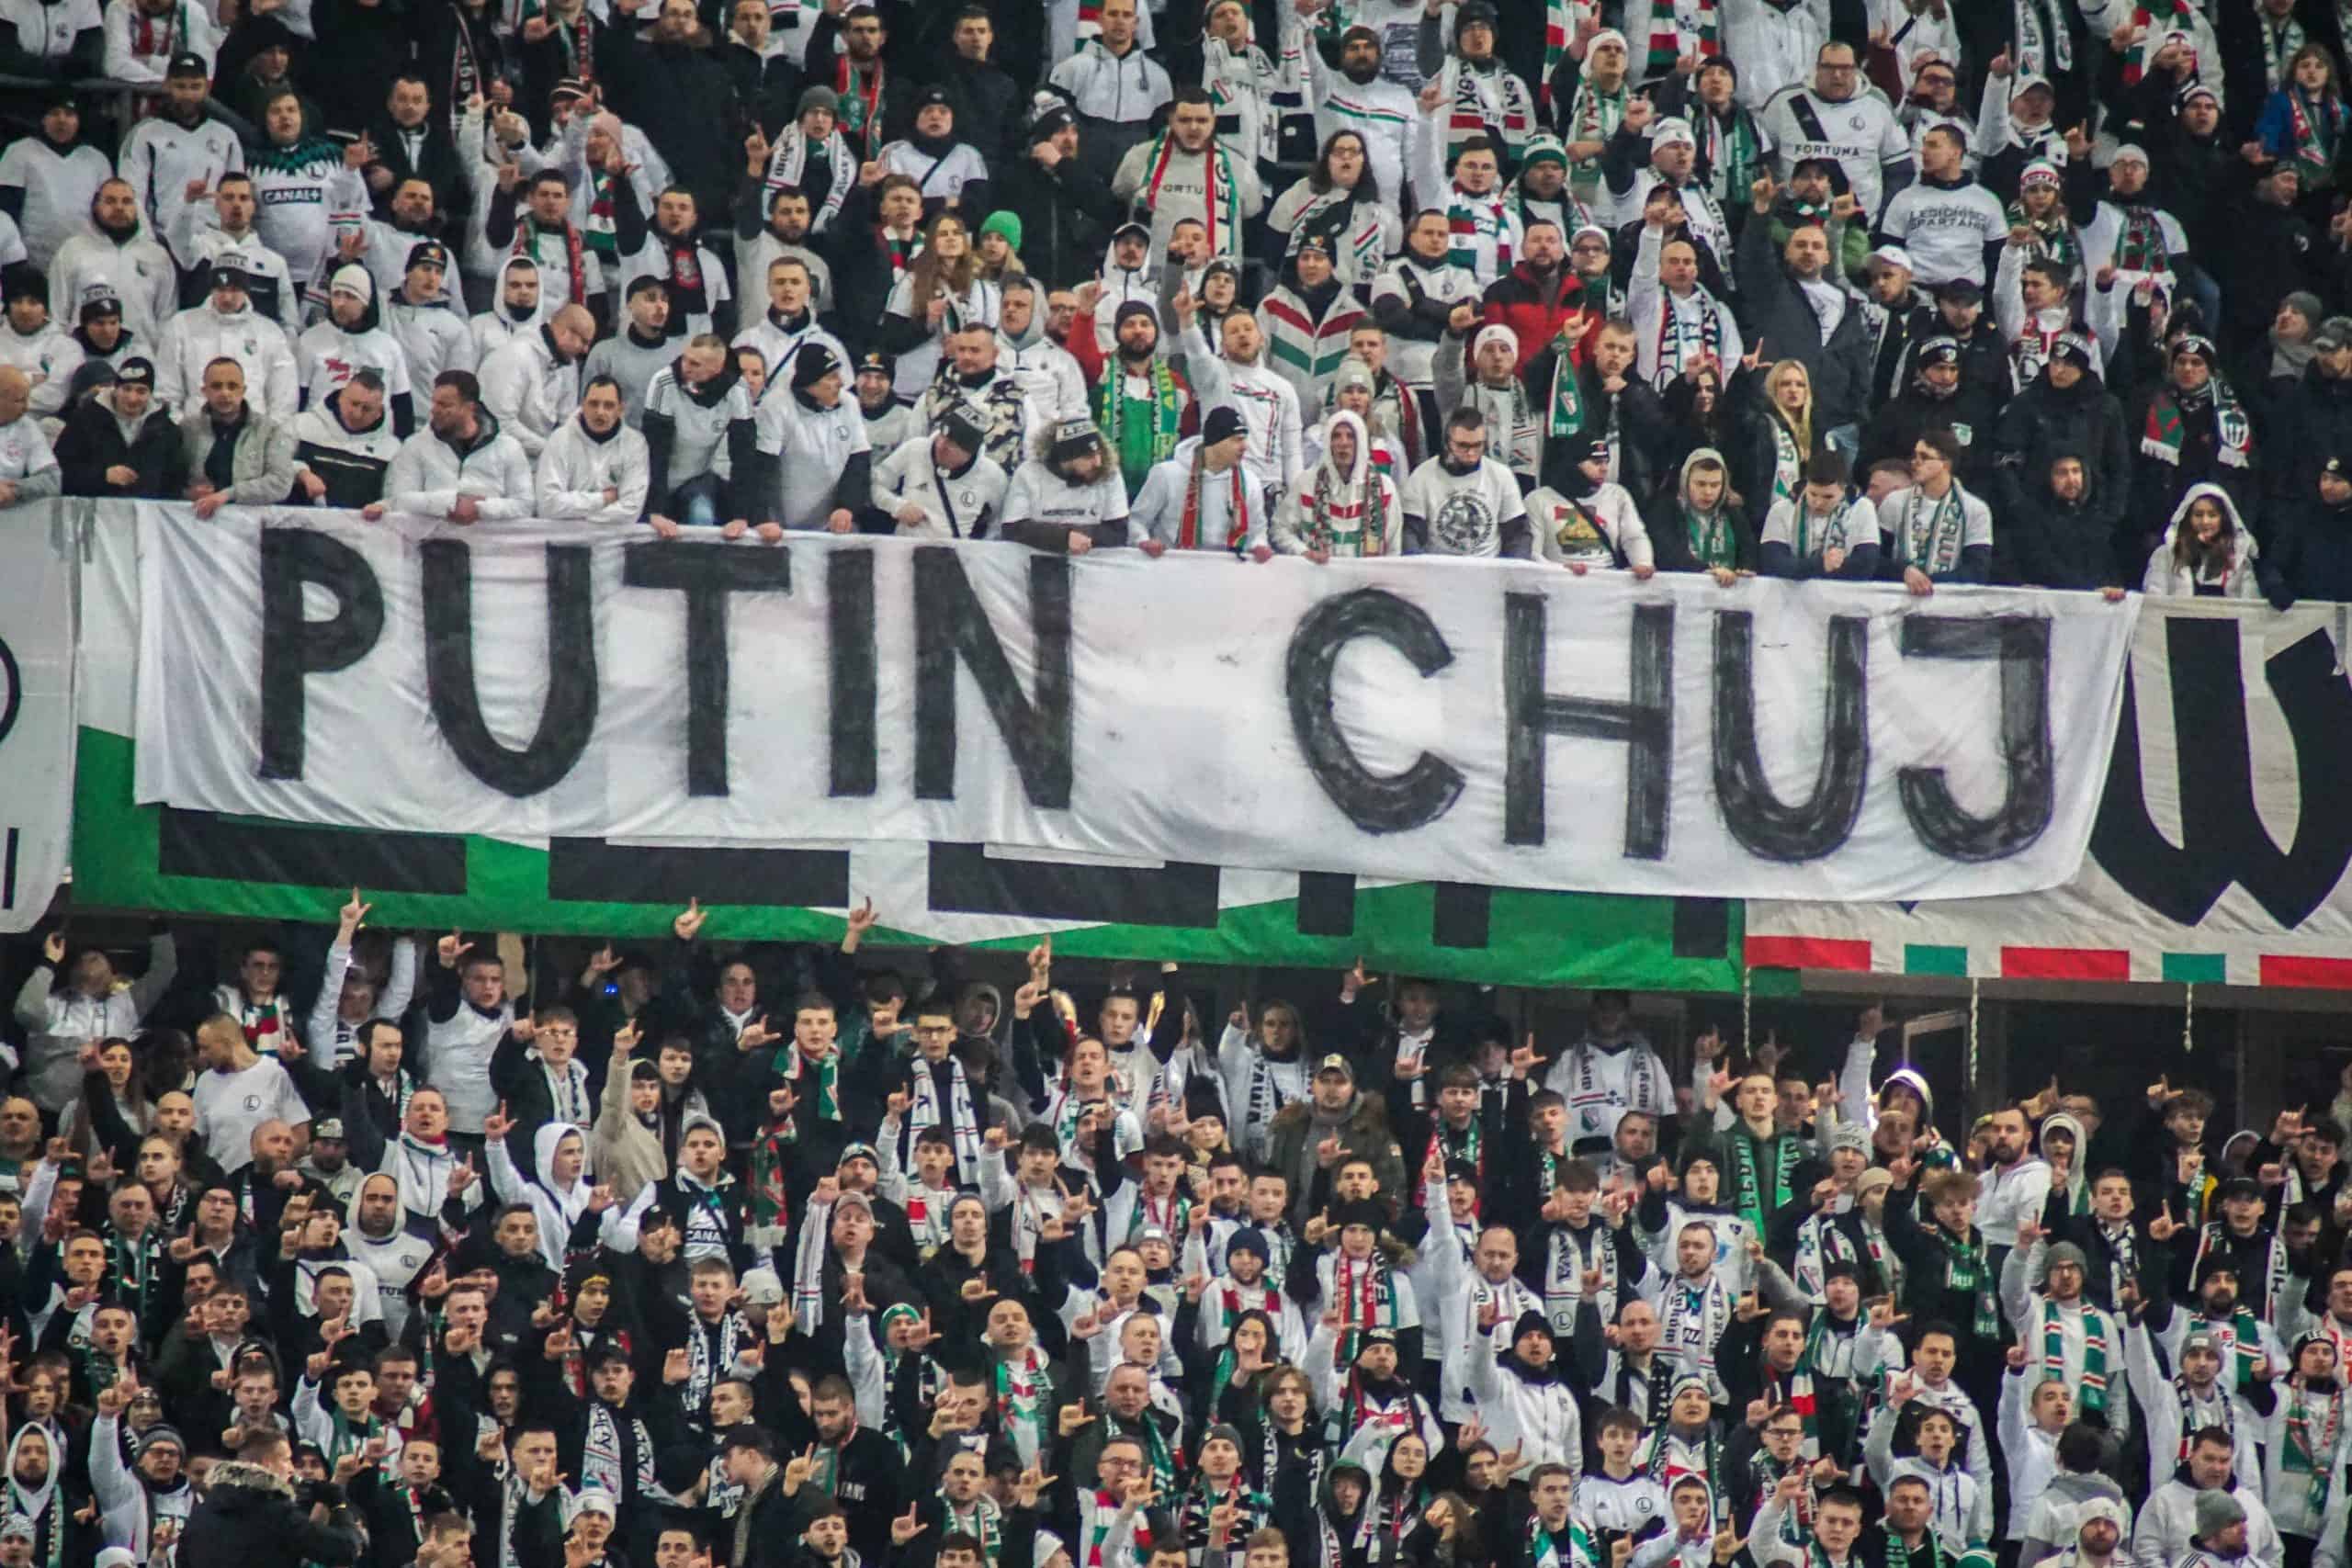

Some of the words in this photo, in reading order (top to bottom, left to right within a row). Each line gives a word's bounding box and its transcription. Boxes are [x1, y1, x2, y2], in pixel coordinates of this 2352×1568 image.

[1794, 144, 1860, 156] FORTUNA
[264, 188, 322, 204] CANAL+
[1163, 184, 1204, 194] ORTU
[260, 527, 1073, 809] PUTIN
[1287, 586, 2053, 862] CHUJ
